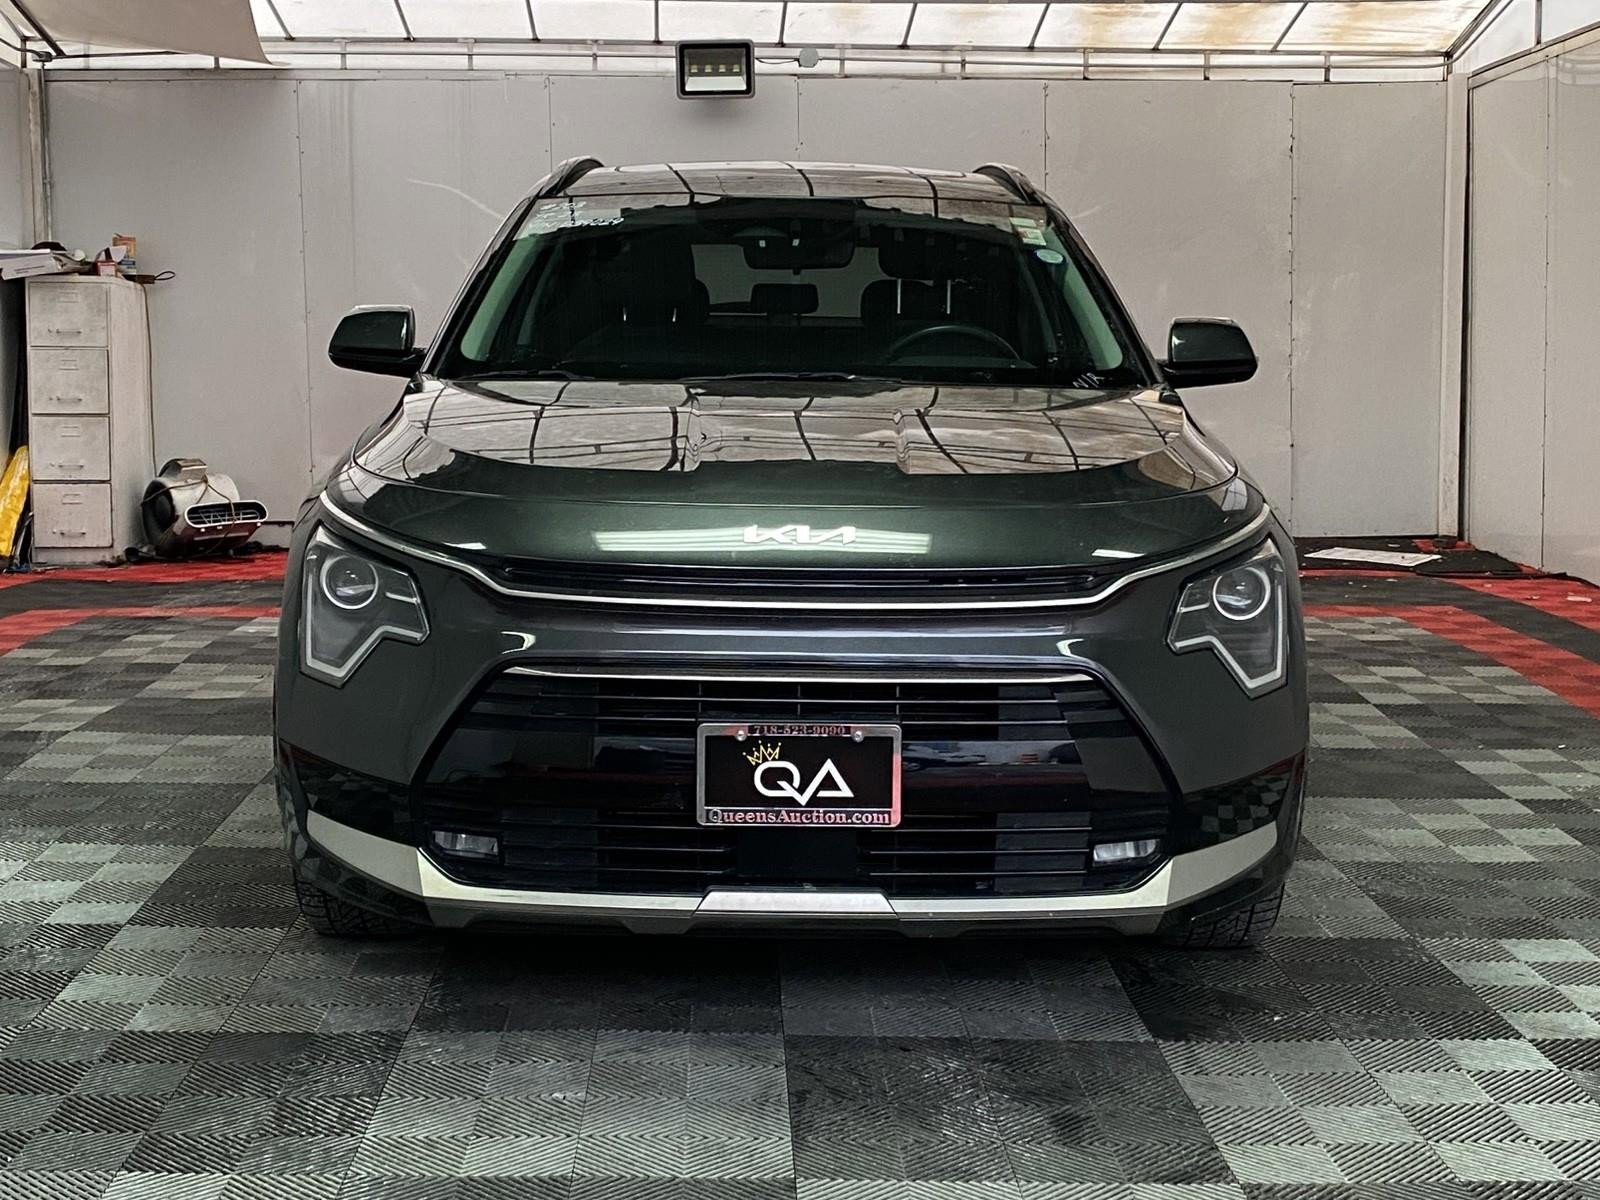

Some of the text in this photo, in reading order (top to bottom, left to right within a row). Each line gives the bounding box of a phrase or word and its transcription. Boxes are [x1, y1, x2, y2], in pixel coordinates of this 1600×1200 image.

[743, 524, 857, 545] KIA
[753, 725, 846, 735] 718-523-9090
[753, 758, 855, 807] QA
[708, 808, 890, 825] QueensAuction.com
